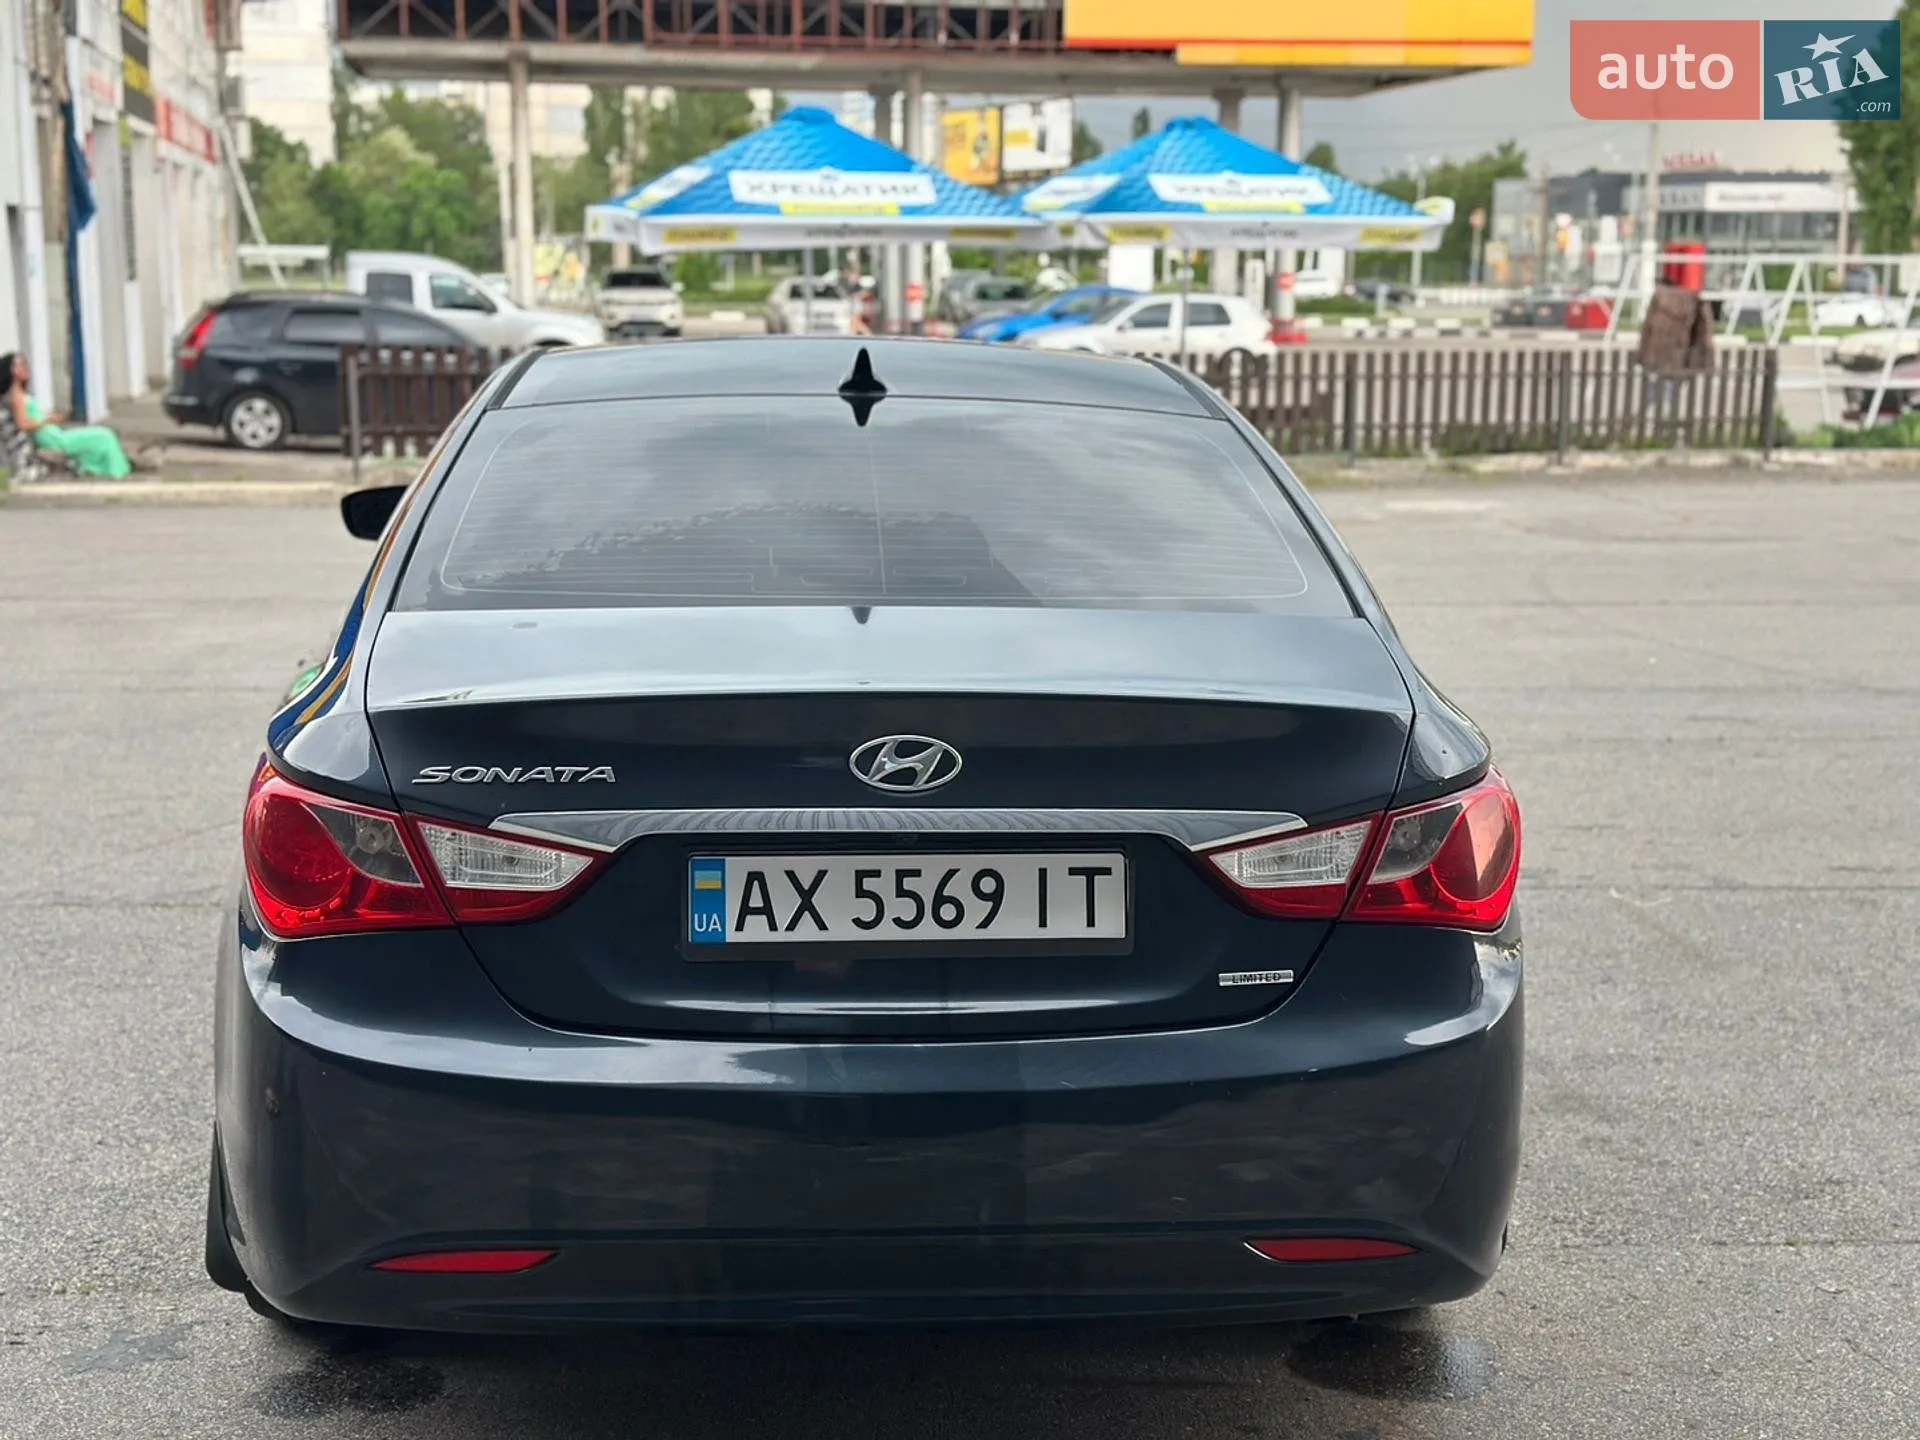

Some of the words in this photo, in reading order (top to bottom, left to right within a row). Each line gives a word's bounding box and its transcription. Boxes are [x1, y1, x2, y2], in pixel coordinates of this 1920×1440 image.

[411, 765, 616, 784] SONATA
[733, 868, 829, 933] AX
[851, 867, 1006, 930] 5569
[1038, 866, 1113, 929] IT
[693, 913, 722, 935] UA
[1231, 972, 1282, 984] LIMITED
